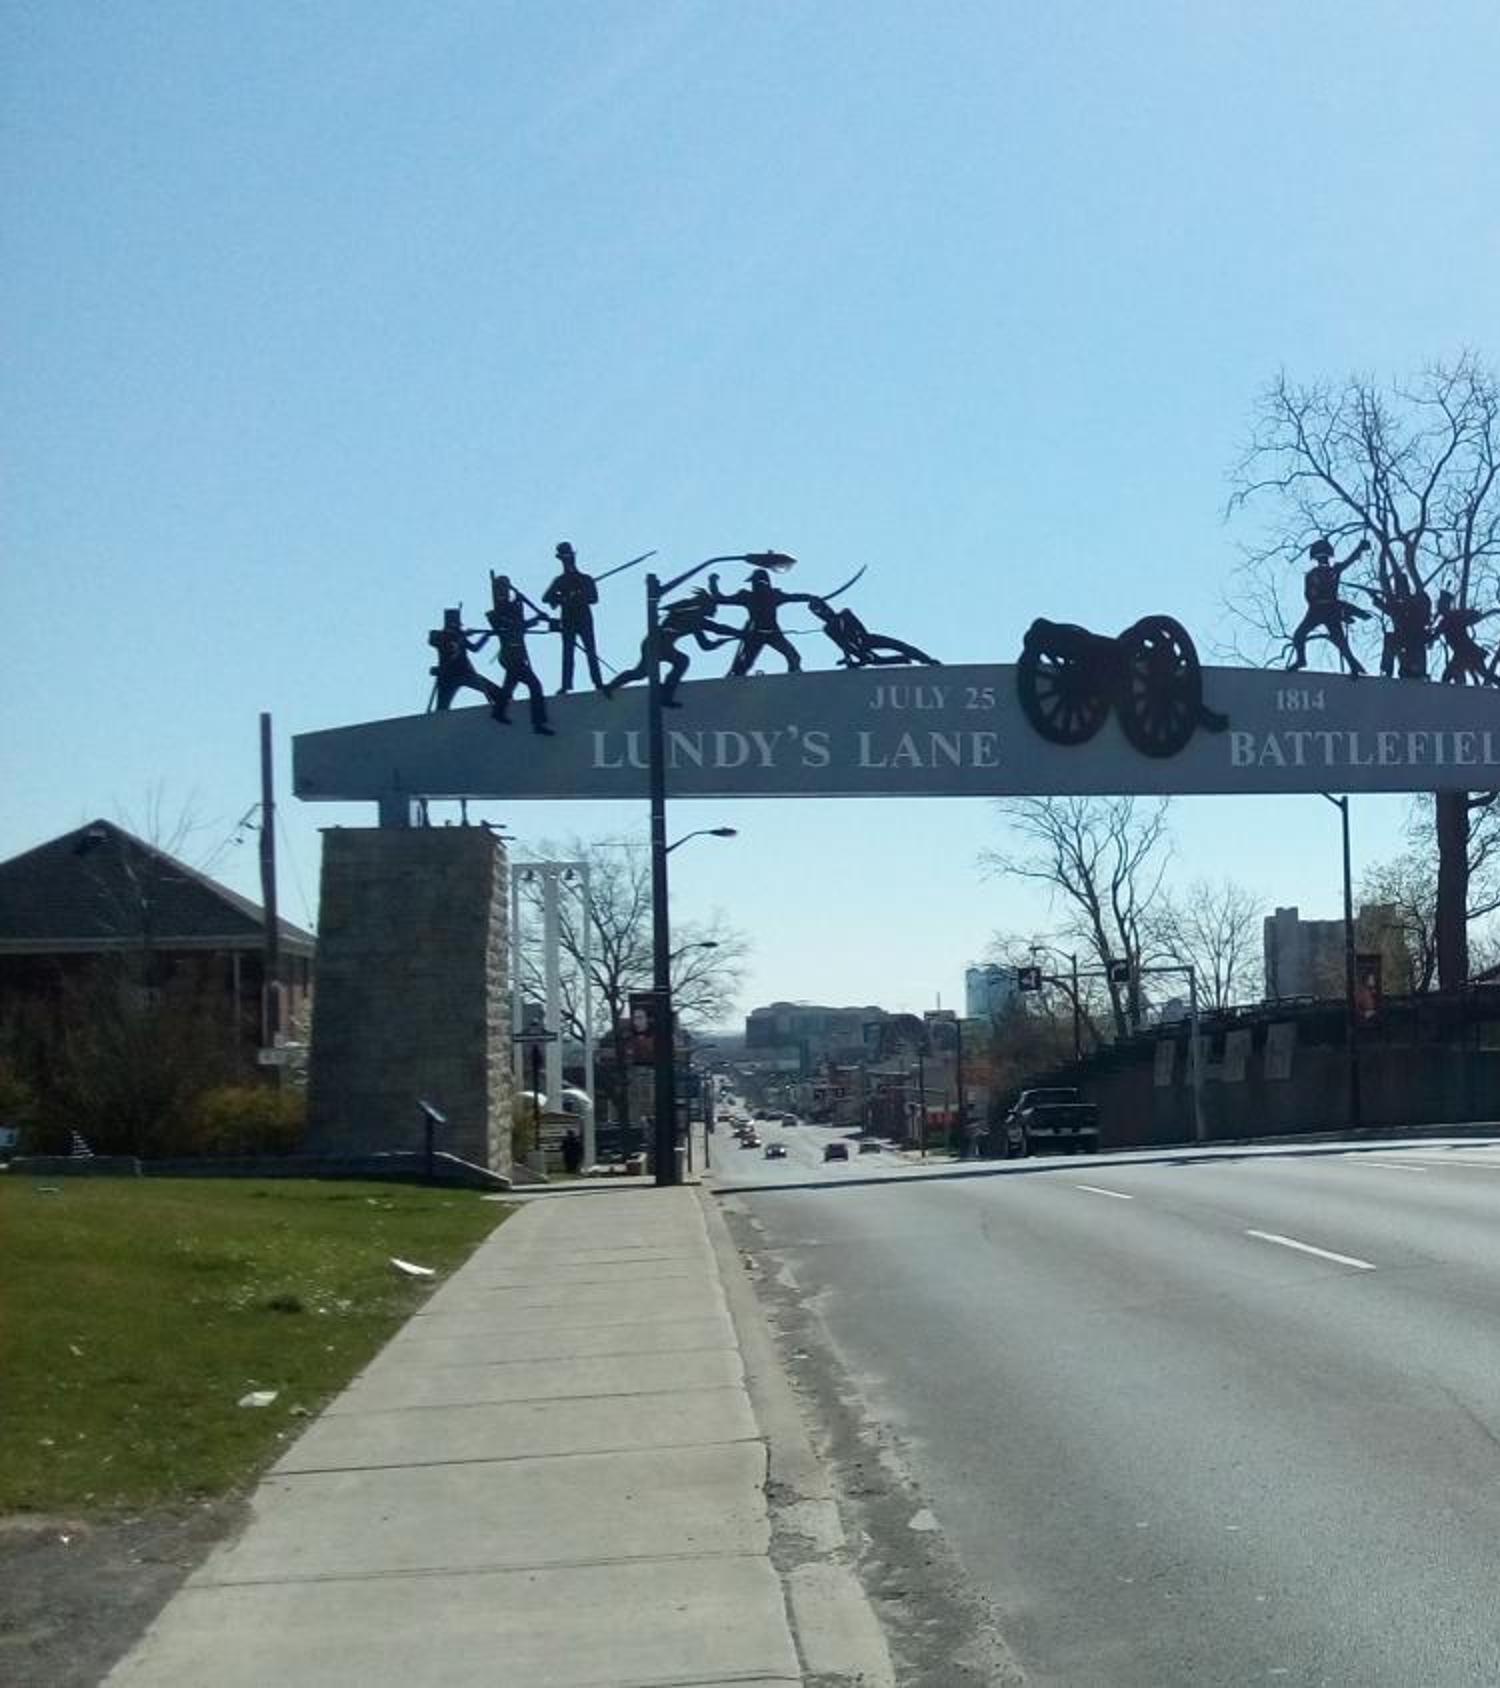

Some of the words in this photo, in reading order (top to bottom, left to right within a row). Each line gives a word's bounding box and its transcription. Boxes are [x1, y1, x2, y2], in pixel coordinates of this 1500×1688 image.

[870, 686, 948, 710] JULY
[966, 687, 996, 709] 25
[1275, 688, 1326, 712] 1814
[591, 725, 832, 768] LUNDY'S
[858, 730, 999, 768] LANE
